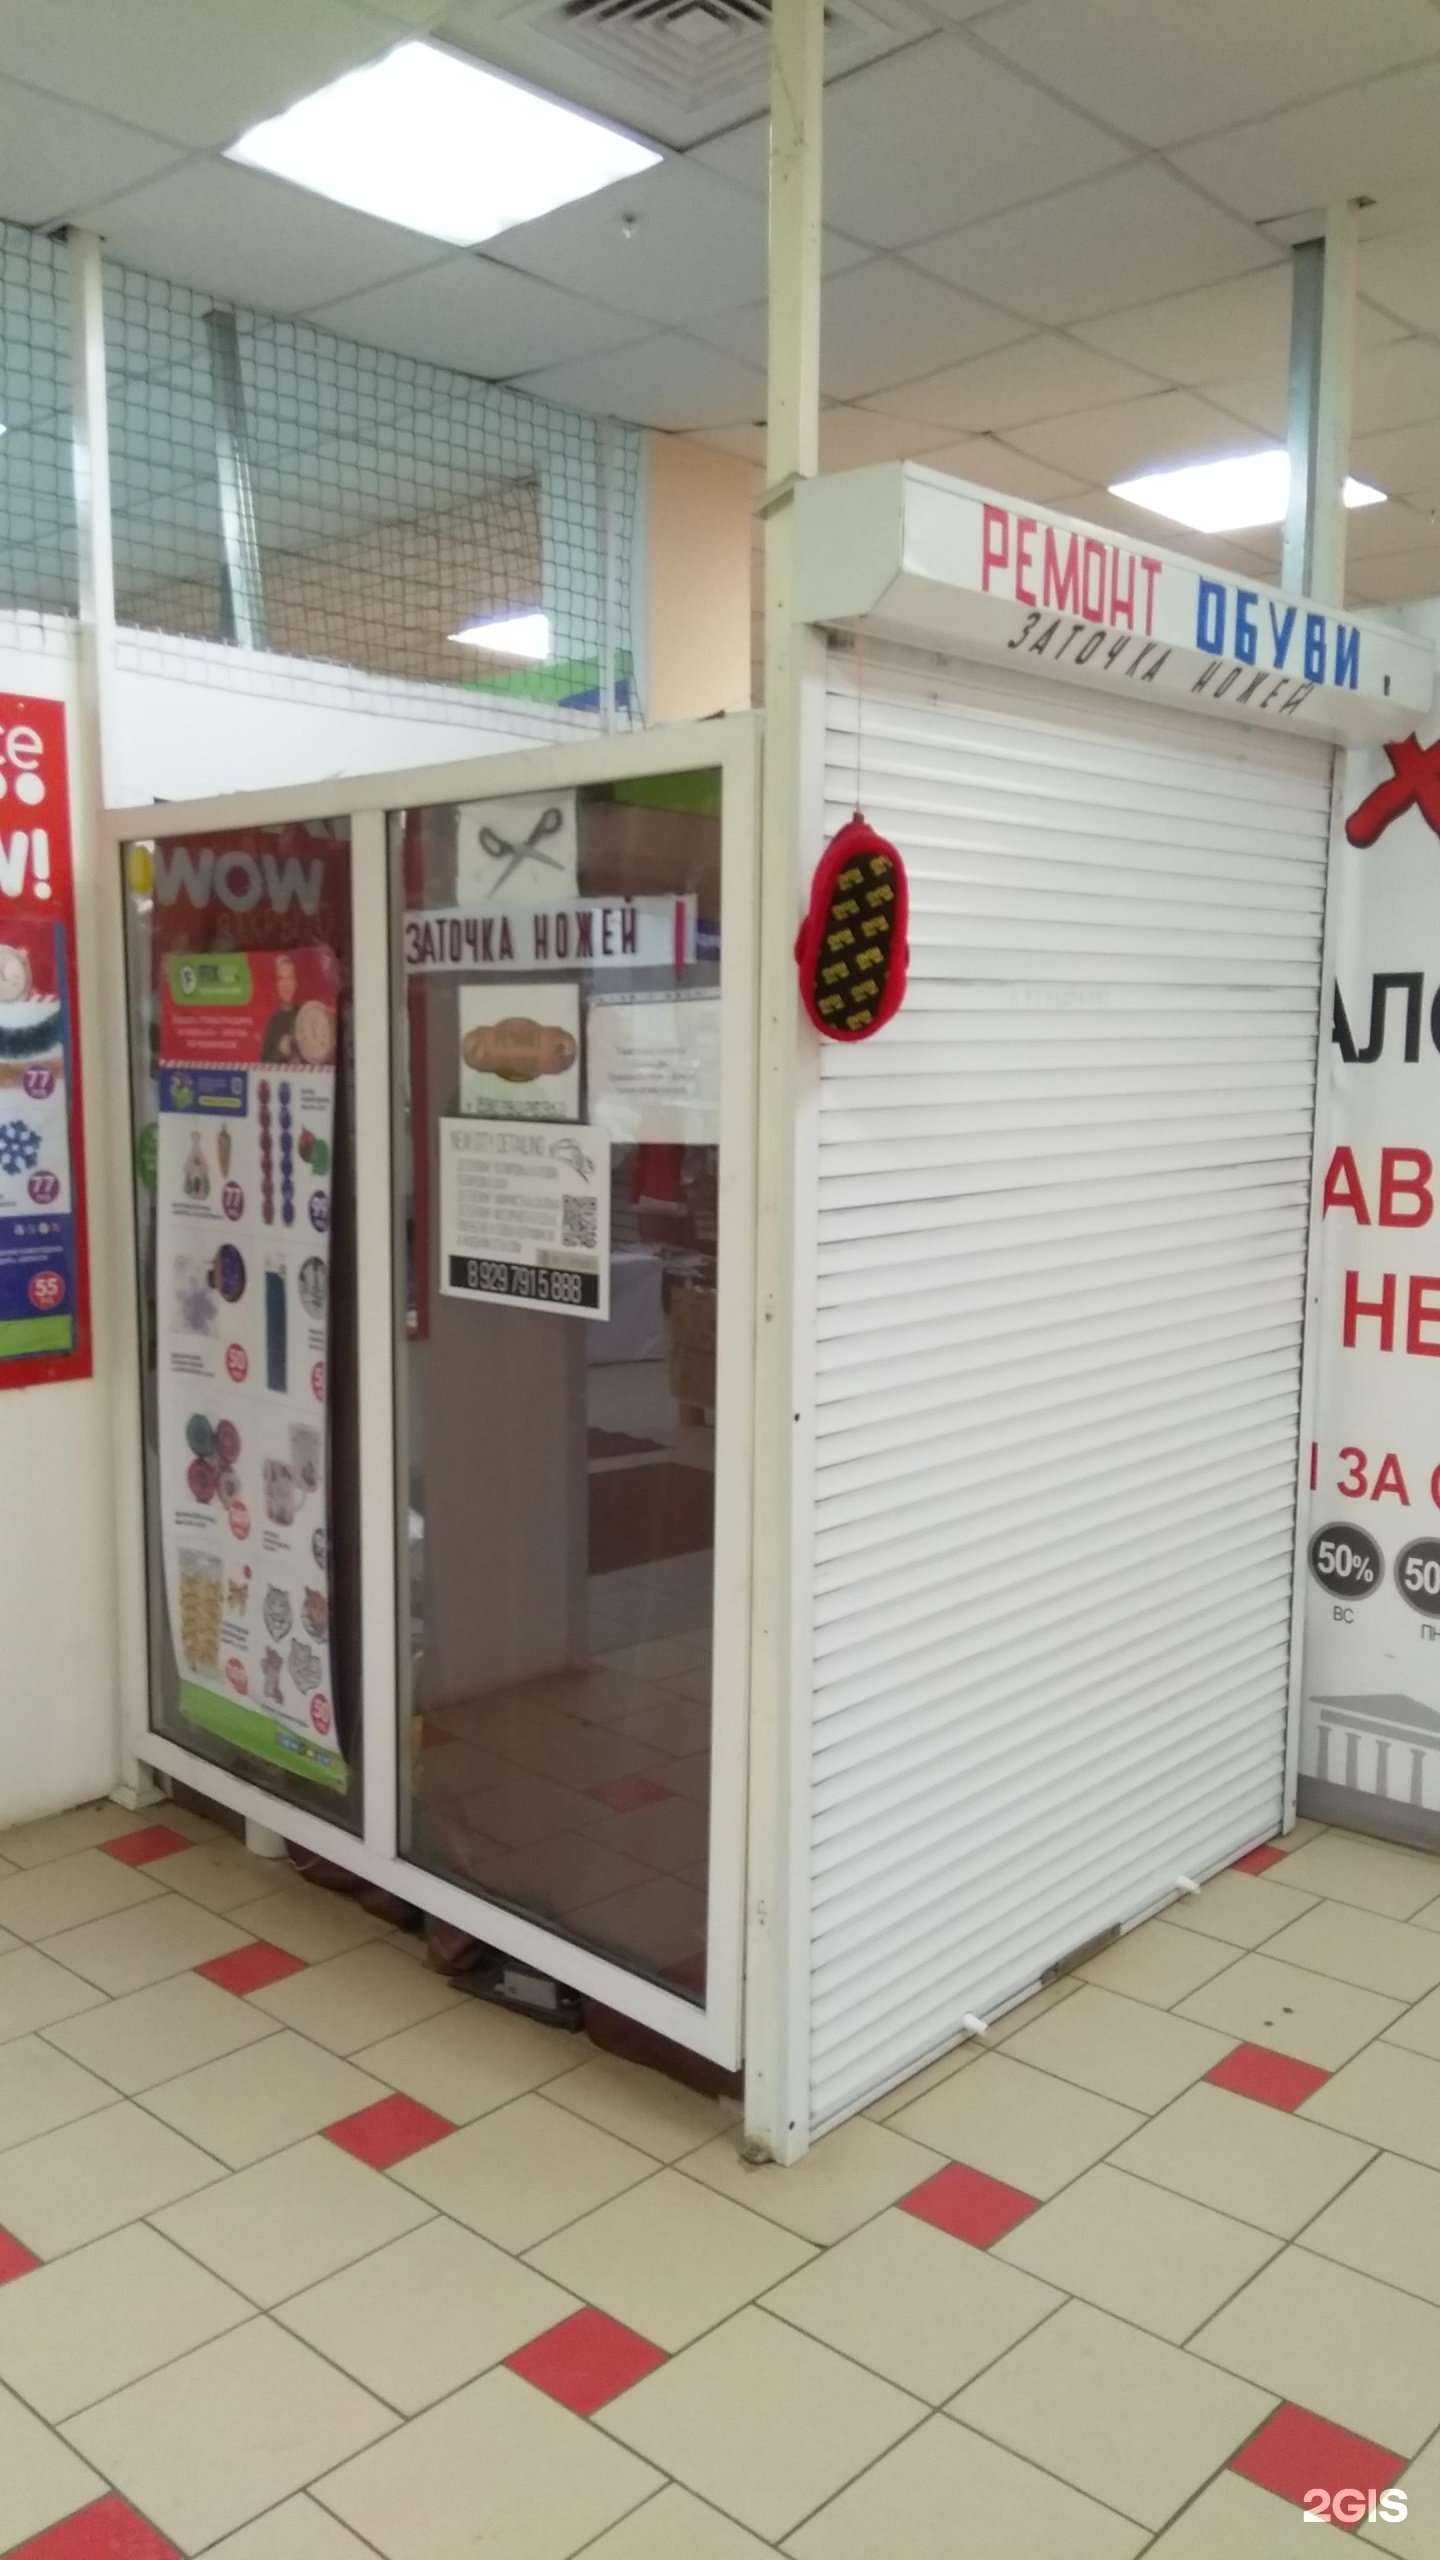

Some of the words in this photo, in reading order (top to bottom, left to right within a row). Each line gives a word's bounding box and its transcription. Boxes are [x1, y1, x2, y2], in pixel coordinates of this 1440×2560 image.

[982, 503, 1162, 636] РЕМОНТ
[1196, 574, 1360, 690] ОБУВИ
[1008, 612, 1172, 683] ЗАТОЧКА
[1190, 661, 1315, 717] НОЖЕЙ
[154, 846, 324, 915] WOW
[405, 915, 515, 964] ЗАТОЧКА
[1322, 1146, 1433, 1228] АВ
[1337, 1447, 1411, 1507] ЗА
[1318, 1540, 1374, 1582] 50%
[1333, 1605, 1354, 1624] ВС
